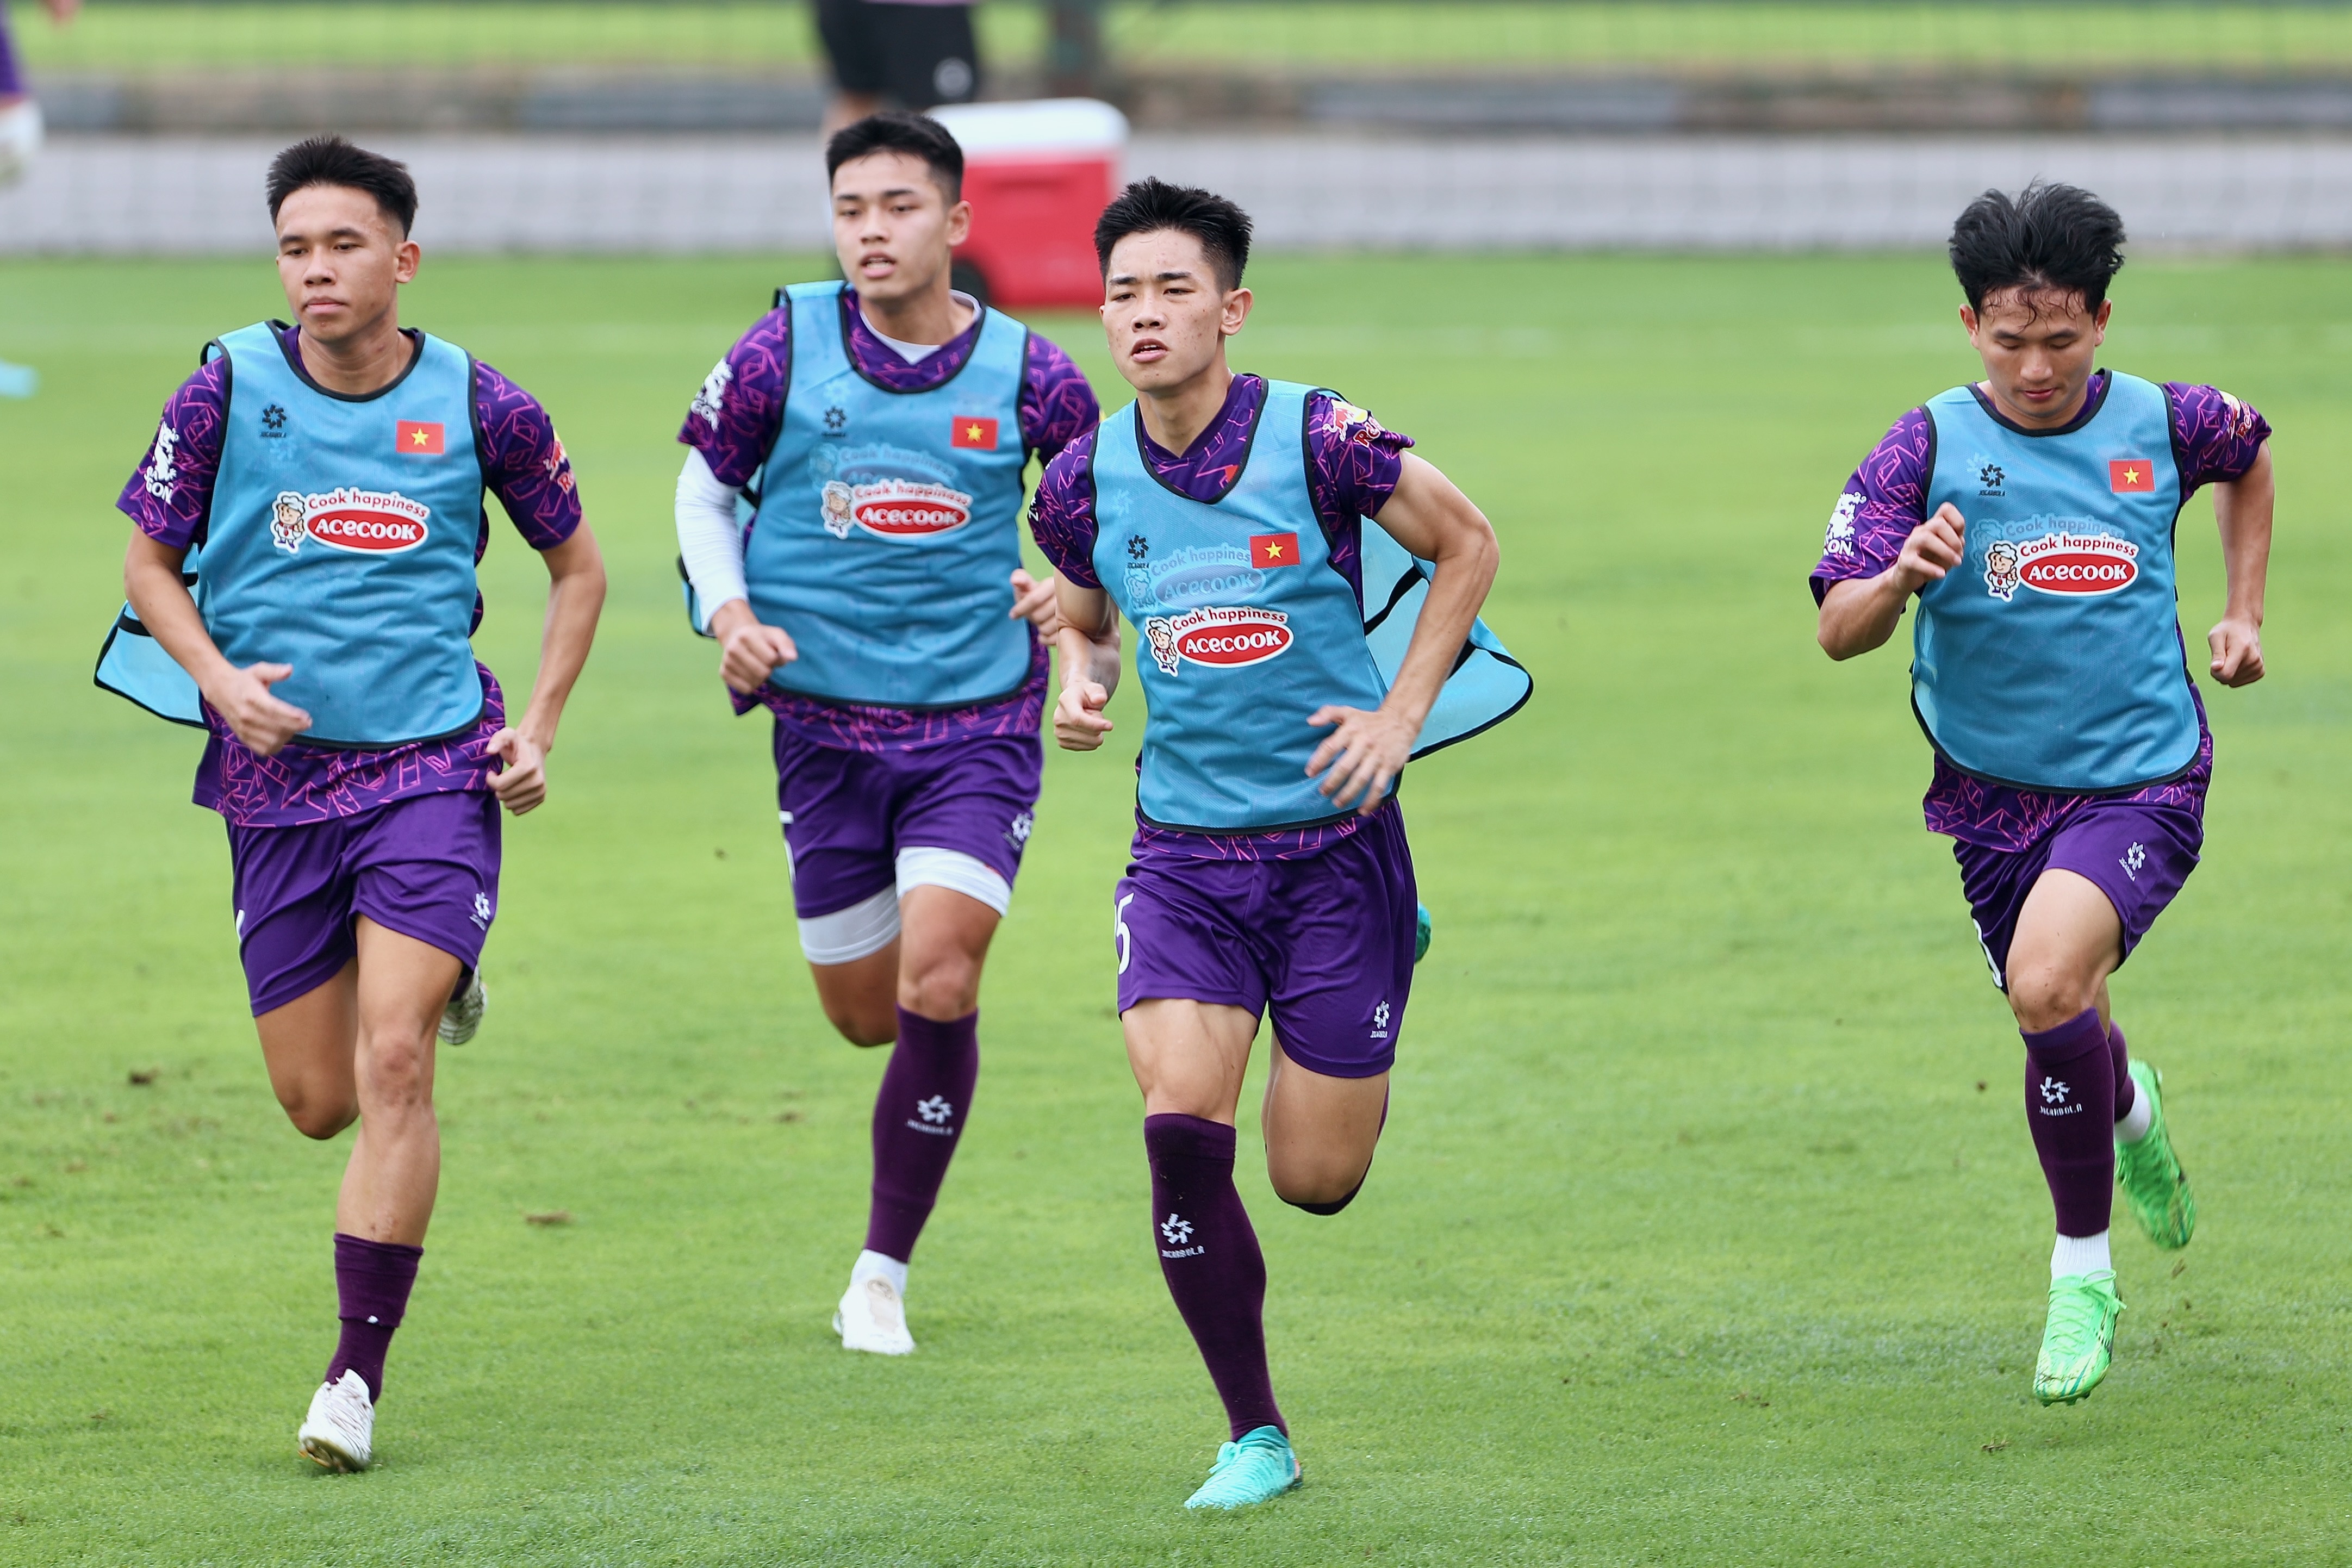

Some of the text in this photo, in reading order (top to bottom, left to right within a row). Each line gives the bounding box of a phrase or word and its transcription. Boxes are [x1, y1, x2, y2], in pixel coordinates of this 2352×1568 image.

[308, 490, 427, 518] Cook happiness
[2020, 535, 2137, 557] Cook happiness
[1150, 548, 1251, 576] Cook happines
[1172, 607, 1286, 631] Cook happiness
